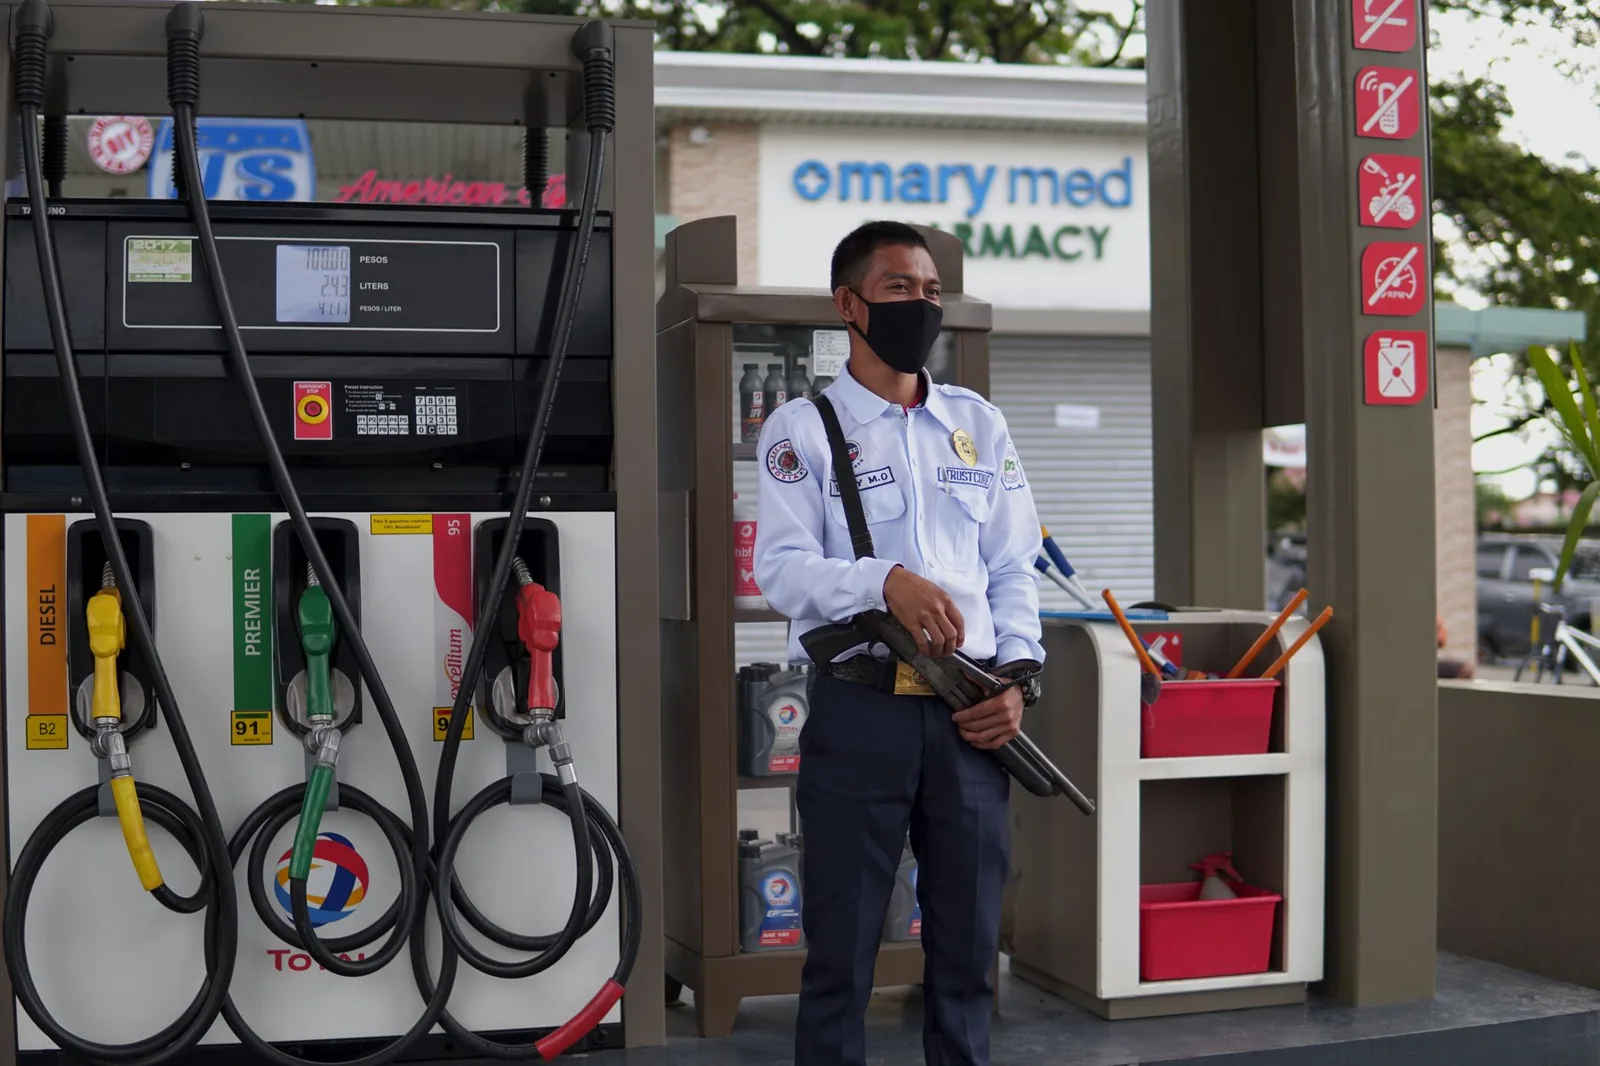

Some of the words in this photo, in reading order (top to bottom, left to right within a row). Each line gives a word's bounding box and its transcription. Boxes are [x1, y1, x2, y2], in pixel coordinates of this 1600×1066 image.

[333, 169, 508, 205] American
[839, 160, 996, 217] mary
[1008, 157, 1133, 208] med
[934, 221, 1111, 261] RMACY
[359, 256, 388, 264] PESOS
[321, 275, 348, 298] 2.43
[359, 282, 389, 290] LITERS
[1387, 291, 1405, 299] RPM
[447, 519, 460, 536] 95
[735, 547, 752, 557] hbf
[39, 584, 56, 646] DIESEL
[244, 567, 261, 656] PREMIER
[39, 722, 56, 735] B2
[235, 721, 258, 736] 91
[437, 717, 449, 732] 9
